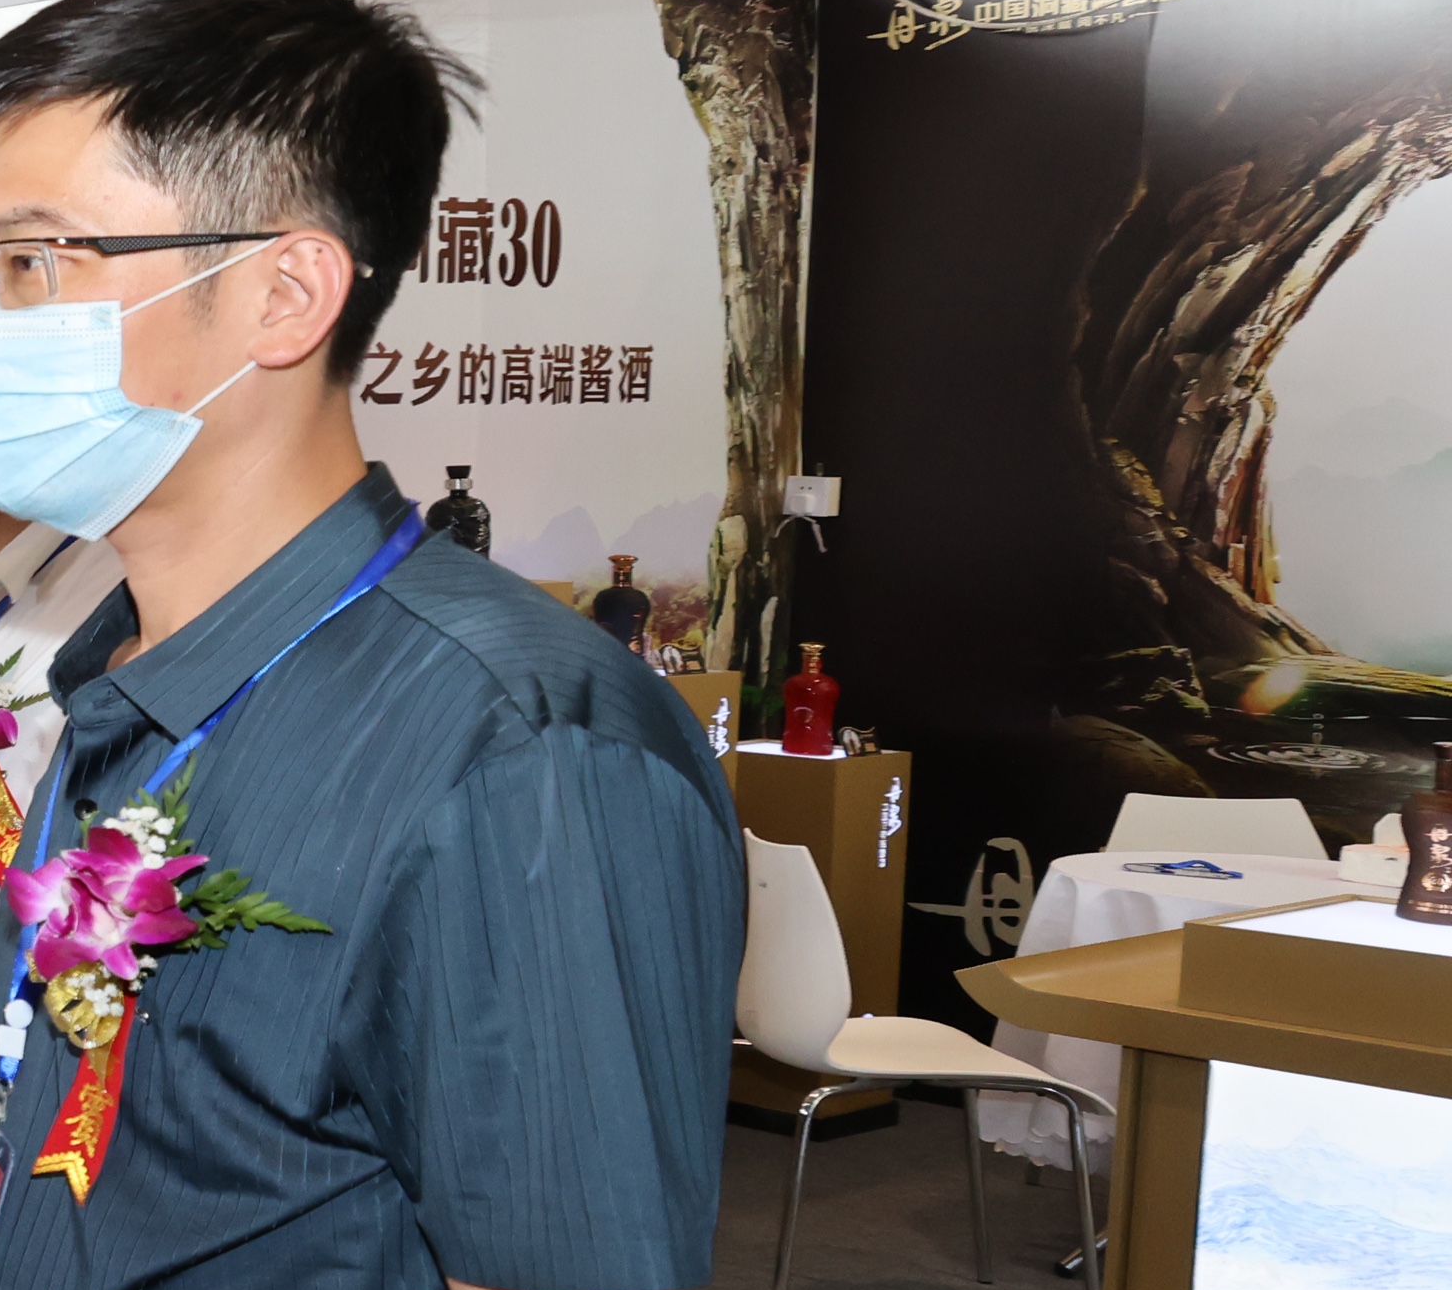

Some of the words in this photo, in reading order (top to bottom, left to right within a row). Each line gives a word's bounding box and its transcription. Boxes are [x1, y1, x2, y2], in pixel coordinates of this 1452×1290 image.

[405, 197, 562, 287] 藏30
[360, 341, 655, 406] 之乡的高端酱酒
